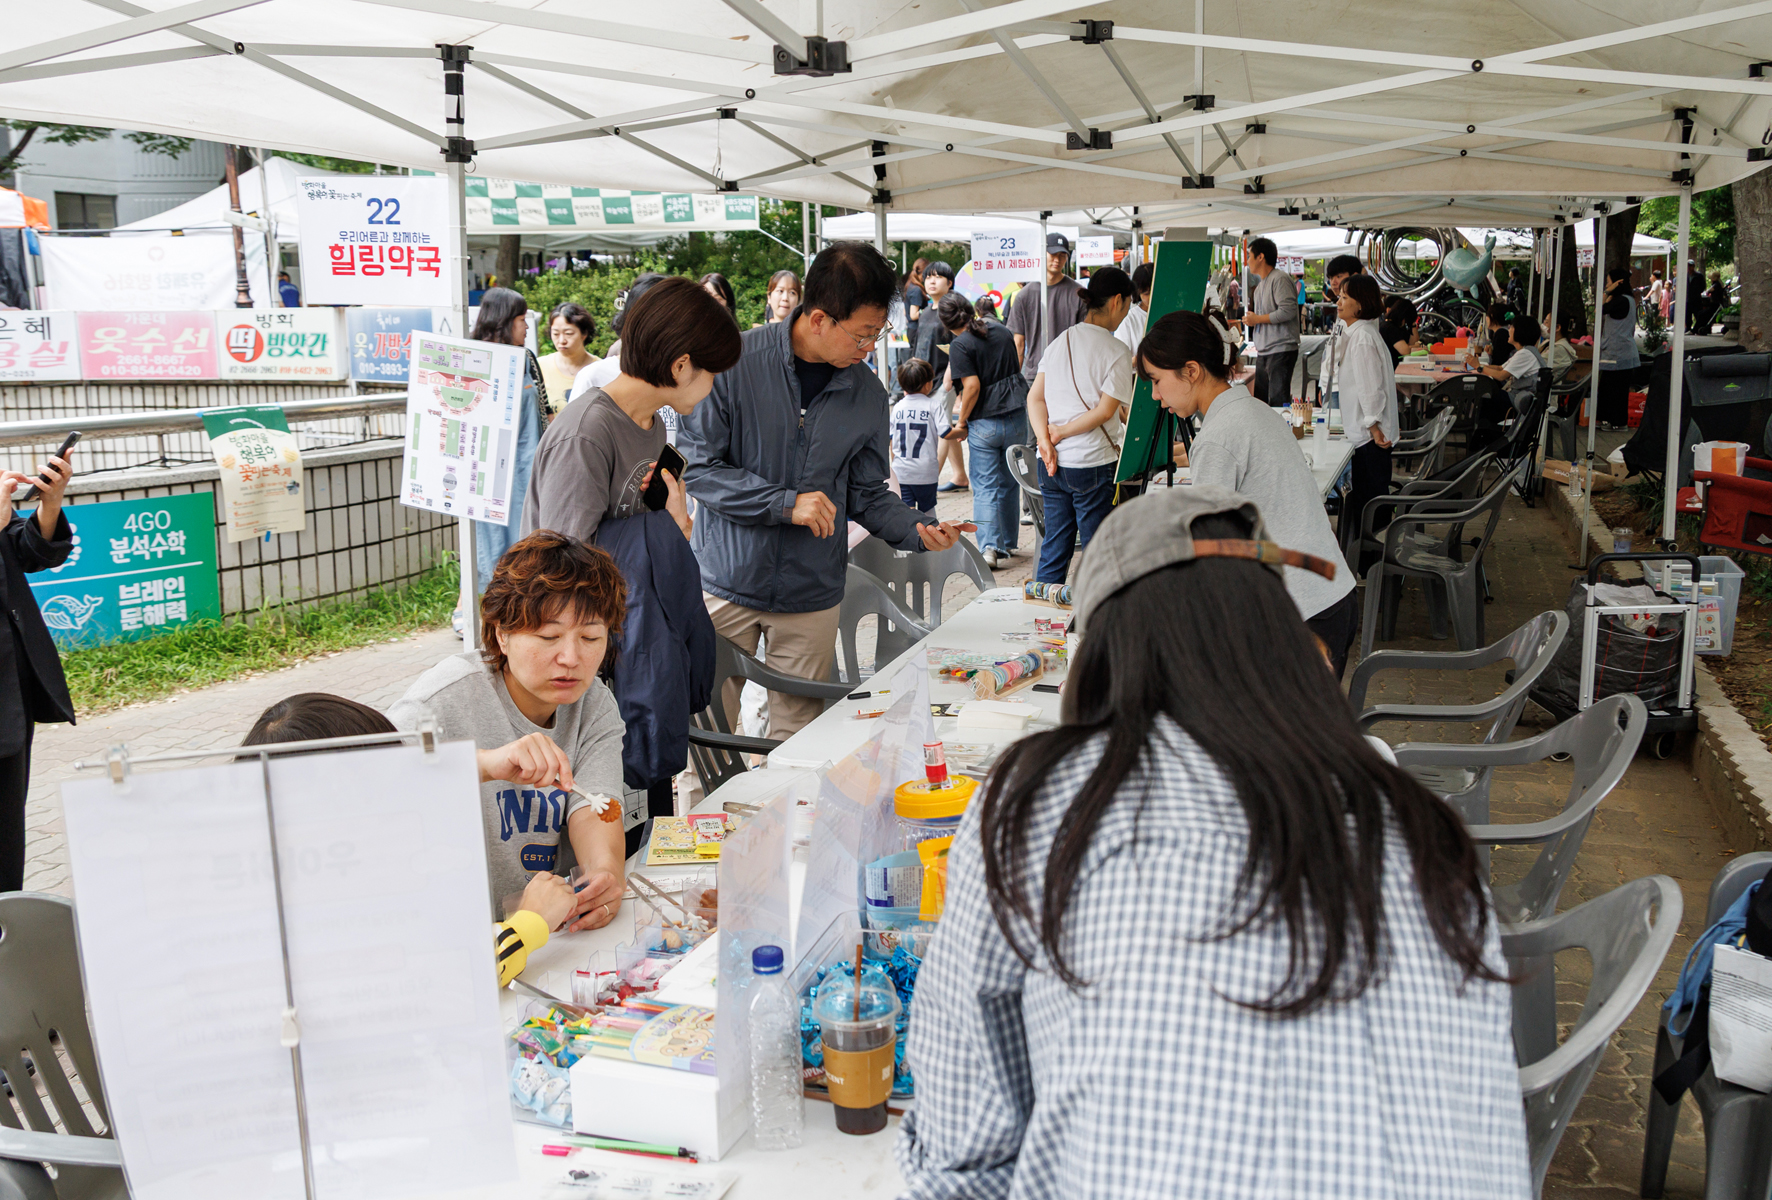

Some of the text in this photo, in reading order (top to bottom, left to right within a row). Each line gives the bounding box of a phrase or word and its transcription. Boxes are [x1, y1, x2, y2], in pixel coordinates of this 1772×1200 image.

[366, 197, 401, 225] 22
[339, 230, 431, 243] 우리어른과 함께하는
[1000, 237, 1016, 249] 23
[329, 243, 441, 278] 힐링약국
[973, 261, 982, 271] 한
[997, 260, 1006, 269] 시
[125, 313, 167, 325] 가운데
[256, 313, 294, 329] 방화
[88, 327, 210, 354] 옷수선
[229, 328, 329, 362] 떡 방앗간
[117, 355, 186, 366] 2661-8667
[359, 362, 411, 376] 010-3893-
[101, 365, 202, 377] 010-8544-0420
[896, 423, 928, 459] 17
[123, 510, 172, 533] 4GO
[109, 530, 187, 564] 분석수학
[118, 575, 186, 606] 브레인
[120, 601, 188, 631] 문해력
[524, 853, 545, 862] EST.
